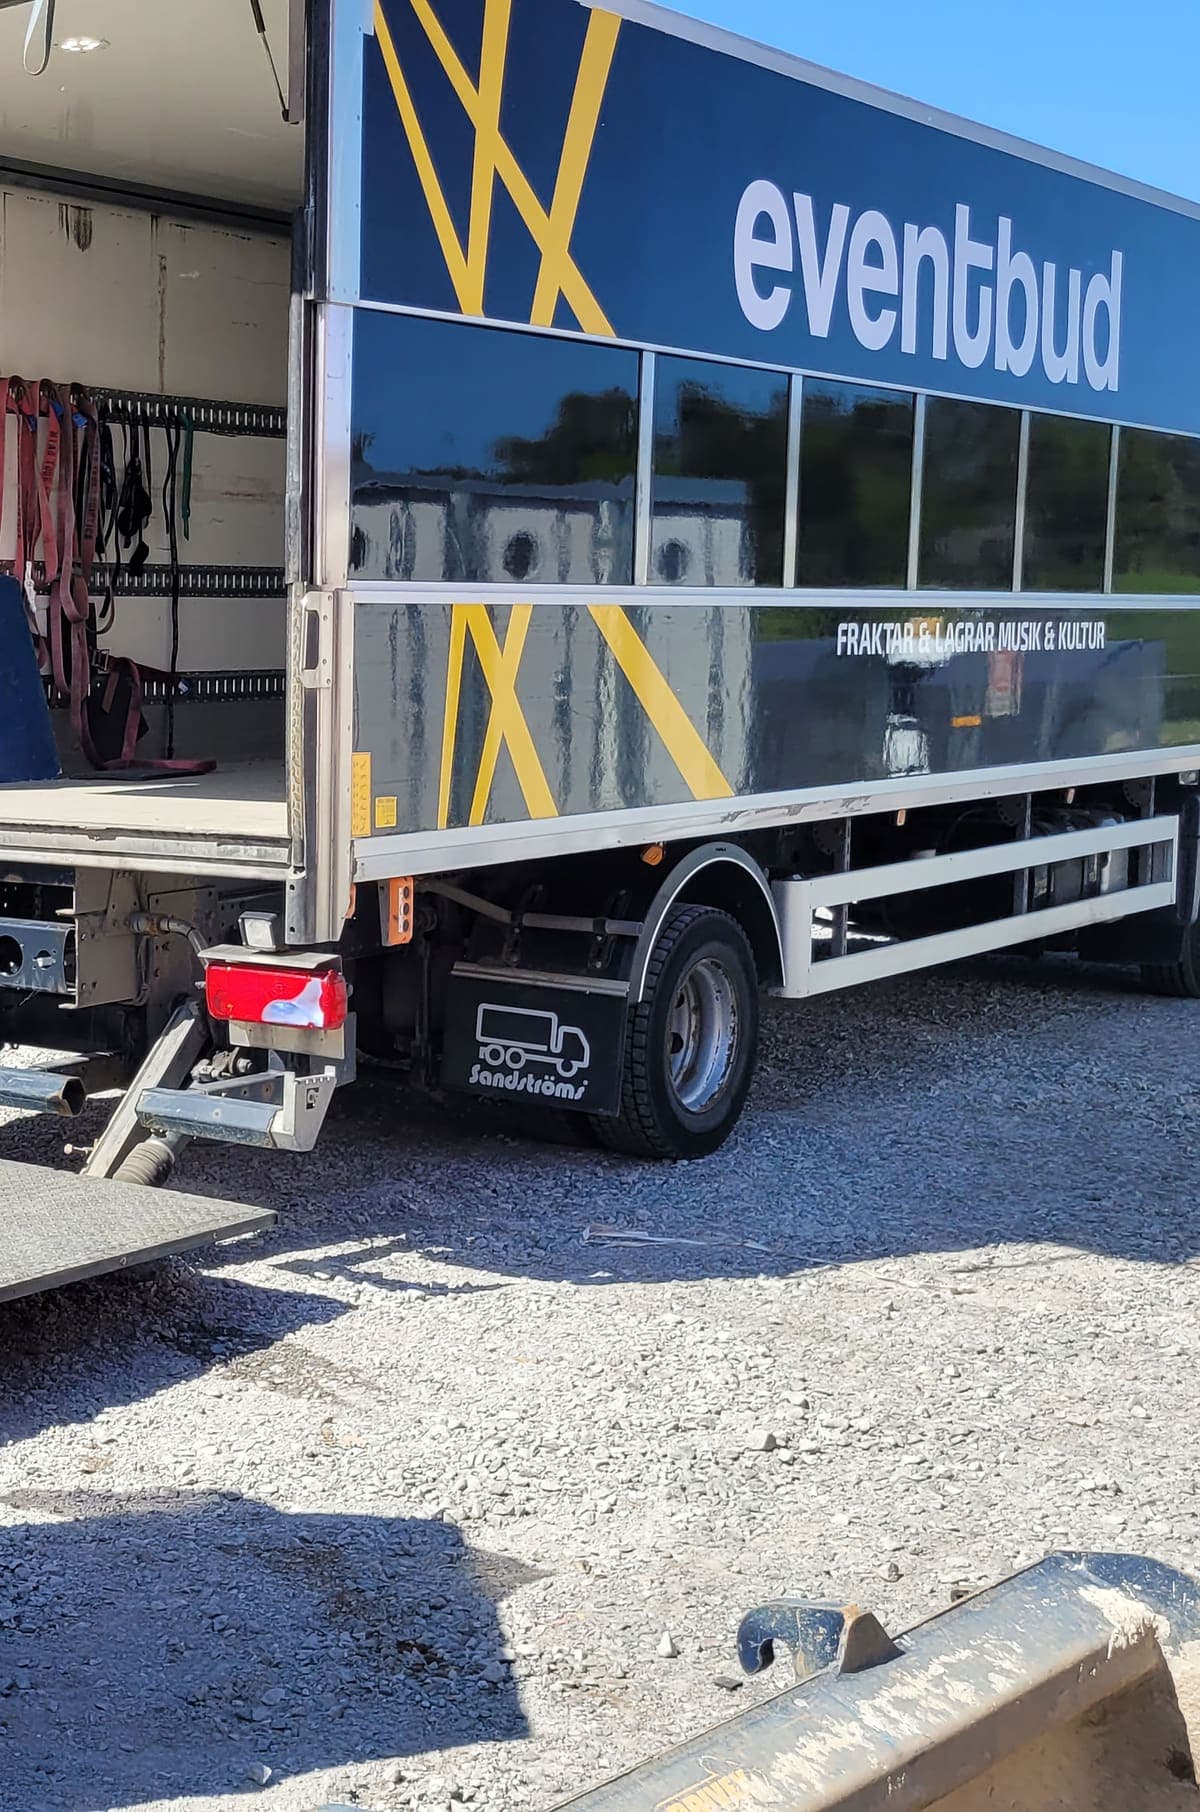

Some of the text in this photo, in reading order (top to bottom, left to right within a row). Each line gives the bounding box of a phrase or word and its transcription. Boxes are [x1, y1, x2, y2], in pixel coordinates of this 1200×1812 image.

[734, 179, 1123, 392] eventbud
[836, 621, 1105, 656] FRAKTAR & LAGRAR MUSIK & KULTUR
